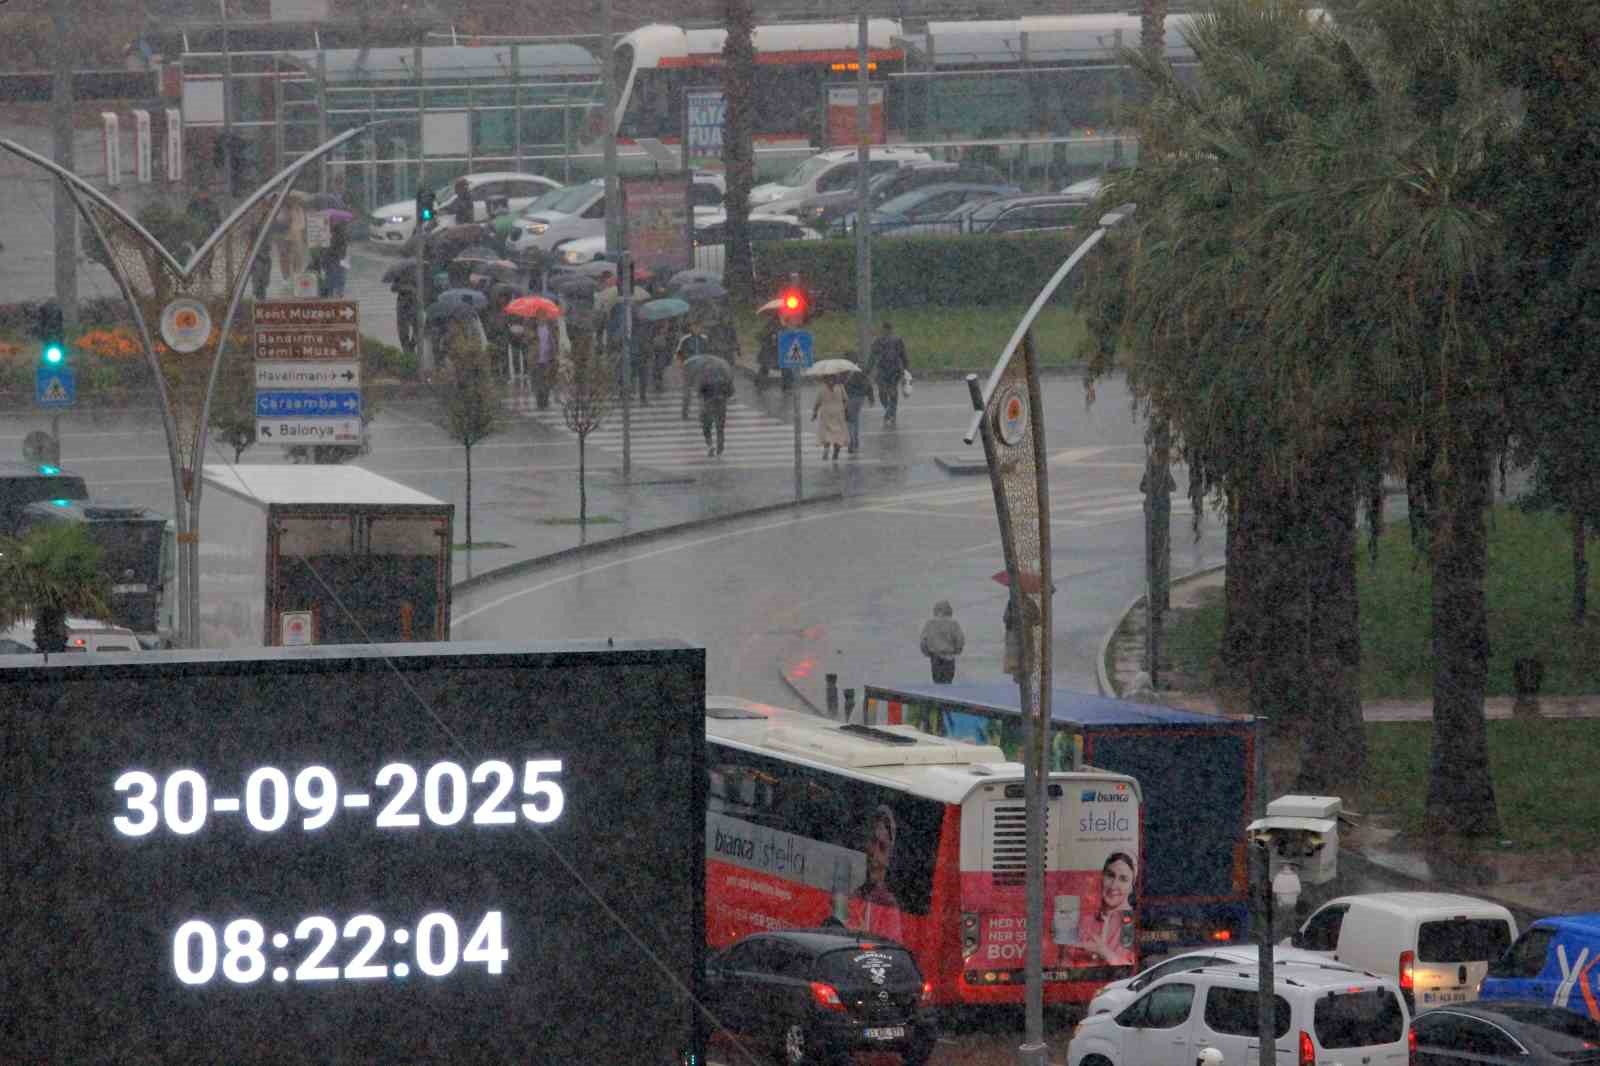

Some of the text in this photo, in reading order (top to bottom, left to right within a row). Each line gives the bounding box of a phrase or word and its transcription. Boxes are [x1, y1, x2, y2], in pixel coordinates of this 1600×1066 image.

[688, 127, 723, 144] FUA
[255, 307, 287, 320] Kent
[112, 758, 565, 837] 30-09-2025
[1096, 791, 1130, 803] bianca
[1079, 810, 1129, 833] stella
[714, 826, 807, 874] bianca stella
[172, 911, 509, 985] 08:22:04
[987, 945, 1026, 959] BOY
